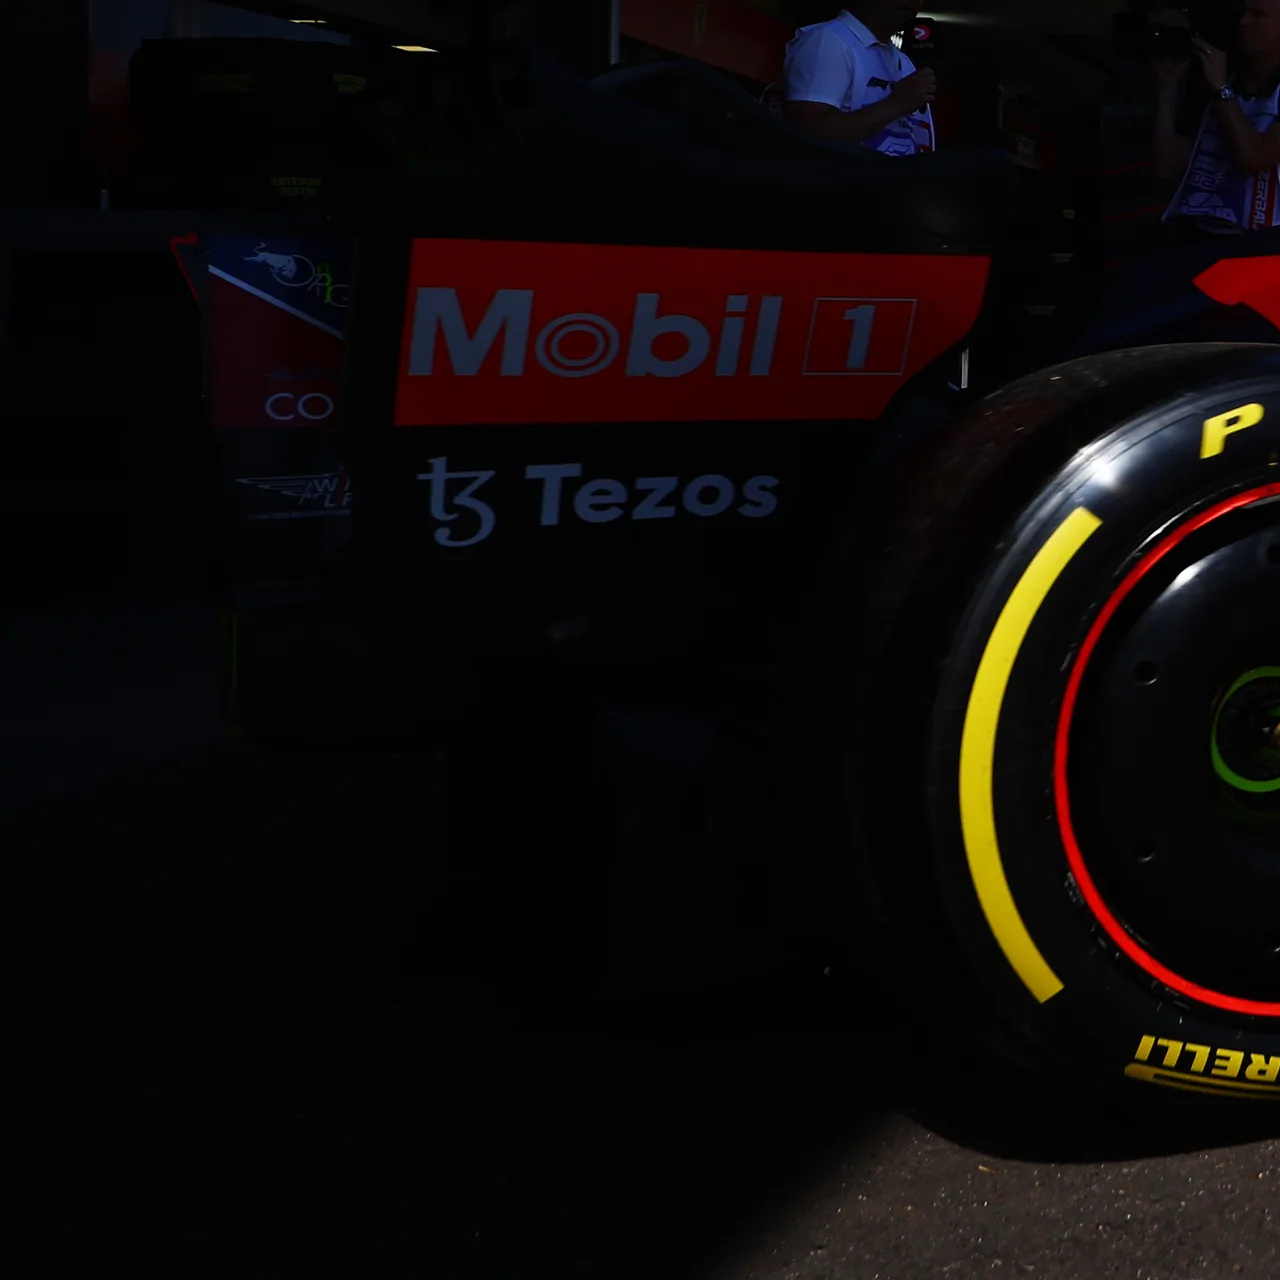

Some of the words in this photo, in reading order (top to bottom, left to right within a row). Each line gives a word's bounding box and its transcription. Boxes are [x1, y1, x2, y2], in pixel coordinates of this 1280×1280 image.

[407, 286, 784, 379] Mobil
[1199, 402, 1266, 461] P
[524, 461, 784, 527] Tezos
